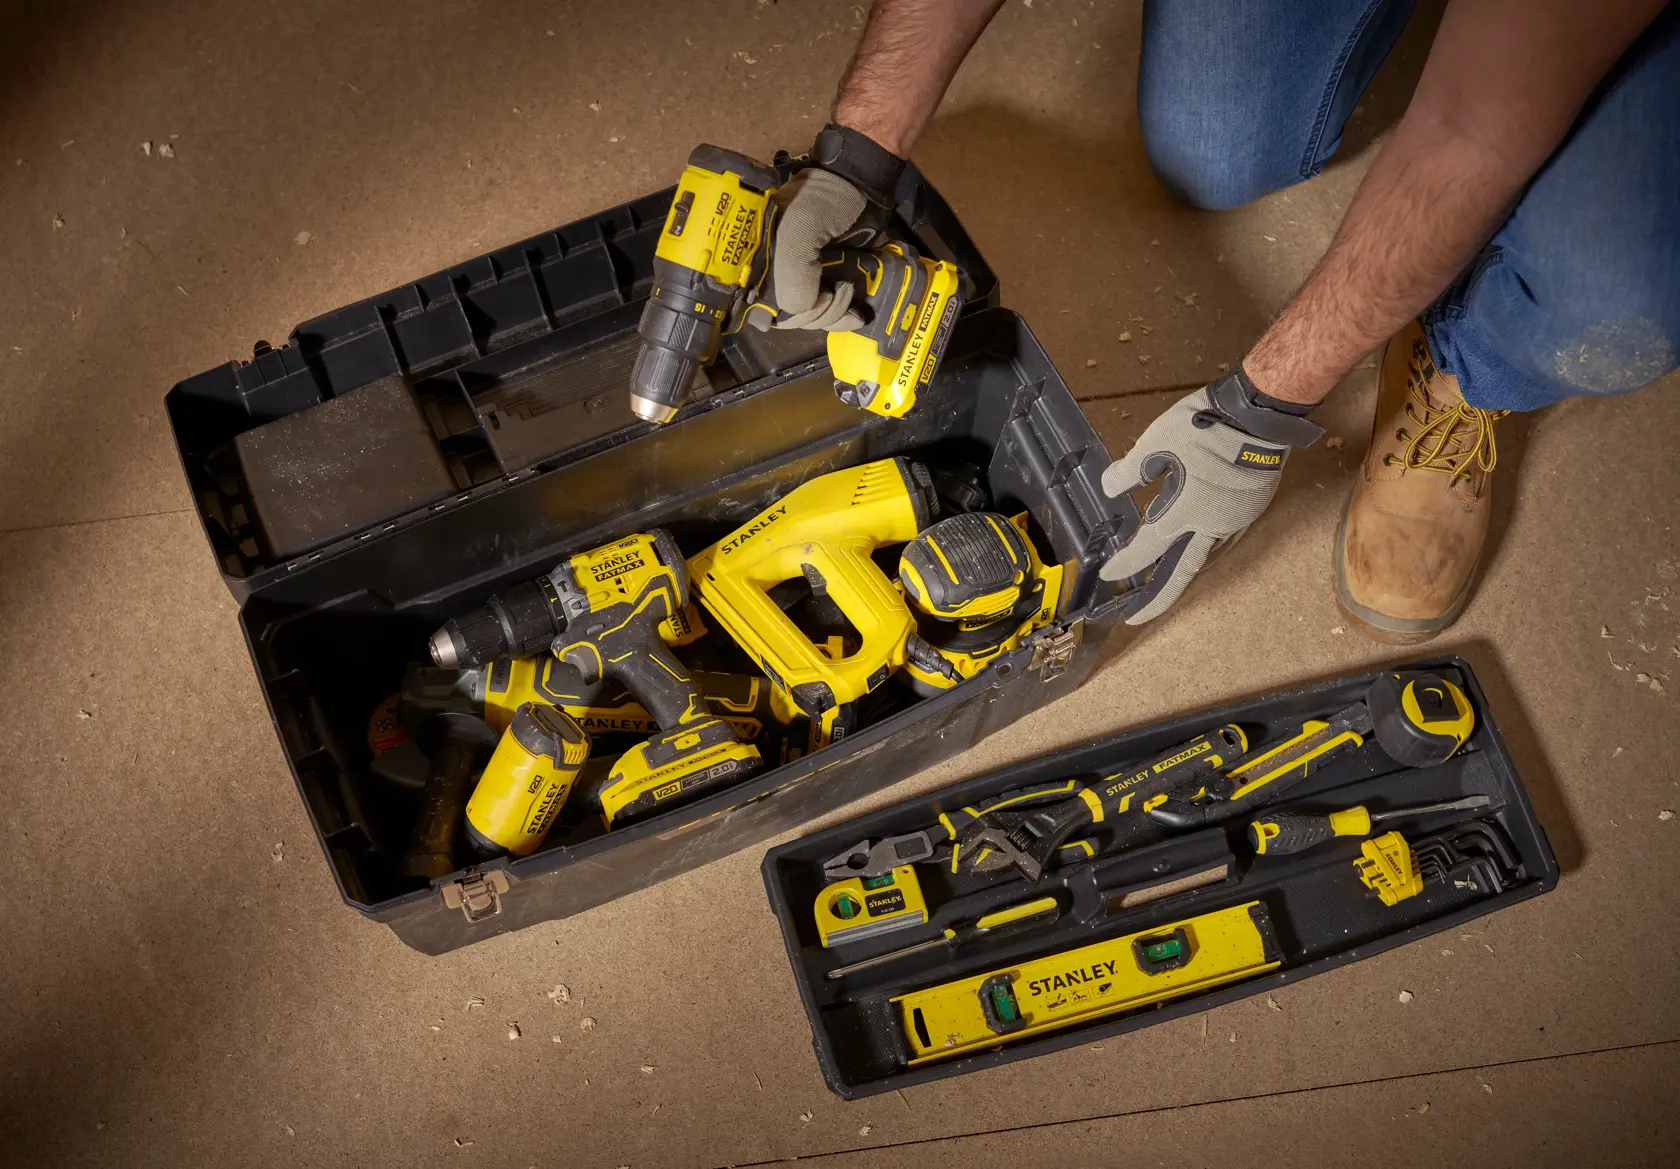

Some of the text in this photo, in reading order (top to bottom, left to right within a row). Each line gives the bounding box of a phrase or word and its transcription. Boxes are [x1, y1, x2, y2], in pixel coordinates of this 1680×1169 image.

[715, 192, 730, 216] V20
[721, 204, 748, 264] STANLEY
[731, 209, 757, 266] FATMAX
[694, 302, 706, 313] 15
[898, 333, 924, 387] STANLEY
[920, 292, 939, 332] FATMAX
[921, 358, 935, 381] V20
[1241, 451, 1281, 465] STANLEY
[721, 505, 787, 555] STANLEY
[590, 550, 640, 575] STANLEY
[596, 560, 645, 582] FATMAX
[670, 613, 684, 638] STAN
[575, 717, 644, 730] TANLEY
[634, 763, 686, 786] STANLEY
[1105, 744, 1207, 797] STANLEY FATMAX
[527, 774, 543, 795] V20
[655, 784, 679, 799] V20
[526, 783, 559, 834] STANLEY
[1385, 853, 1403, 875] STANLEY
[868, 896, 902, 908] STANLEY
[1029, 960, 1118, 996] STANLEY
